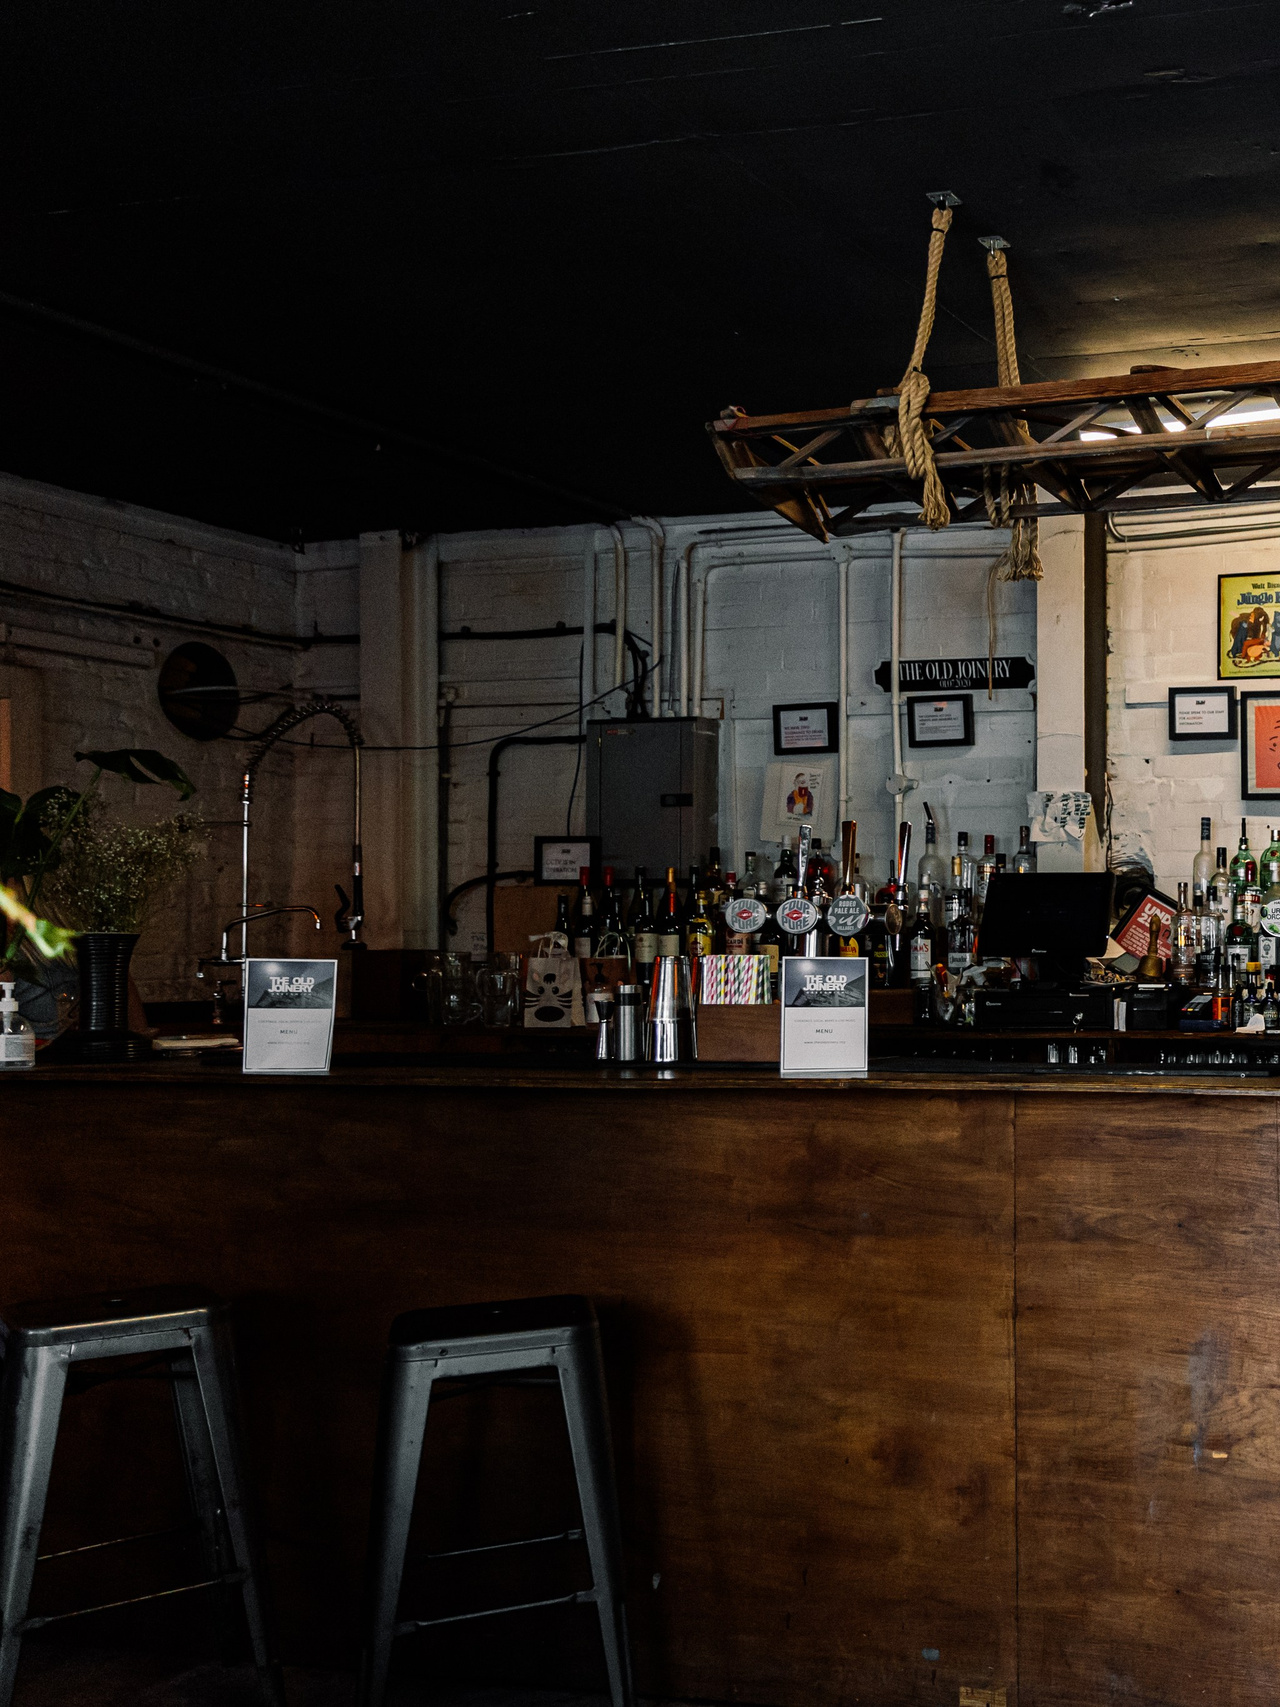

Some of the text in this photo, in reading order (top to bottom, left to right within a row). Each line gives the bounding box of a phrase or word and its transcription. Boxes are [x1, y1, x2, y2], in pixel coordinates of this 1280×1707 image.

[1237, 592, 1273, 605] Jungle
[899, 663, 923, 681] THE
[925, 662, 953, 680] OLD
[731, 915, 759, 929] PURE
[781, 915, 810, 930] PURE
[269, 976, 315, 985] THE OLD
[804, 975, 847, 983] THE OLD
[267, 984, 315, 993] JOINERY
[802, 982, 847, 991] JOINERY
